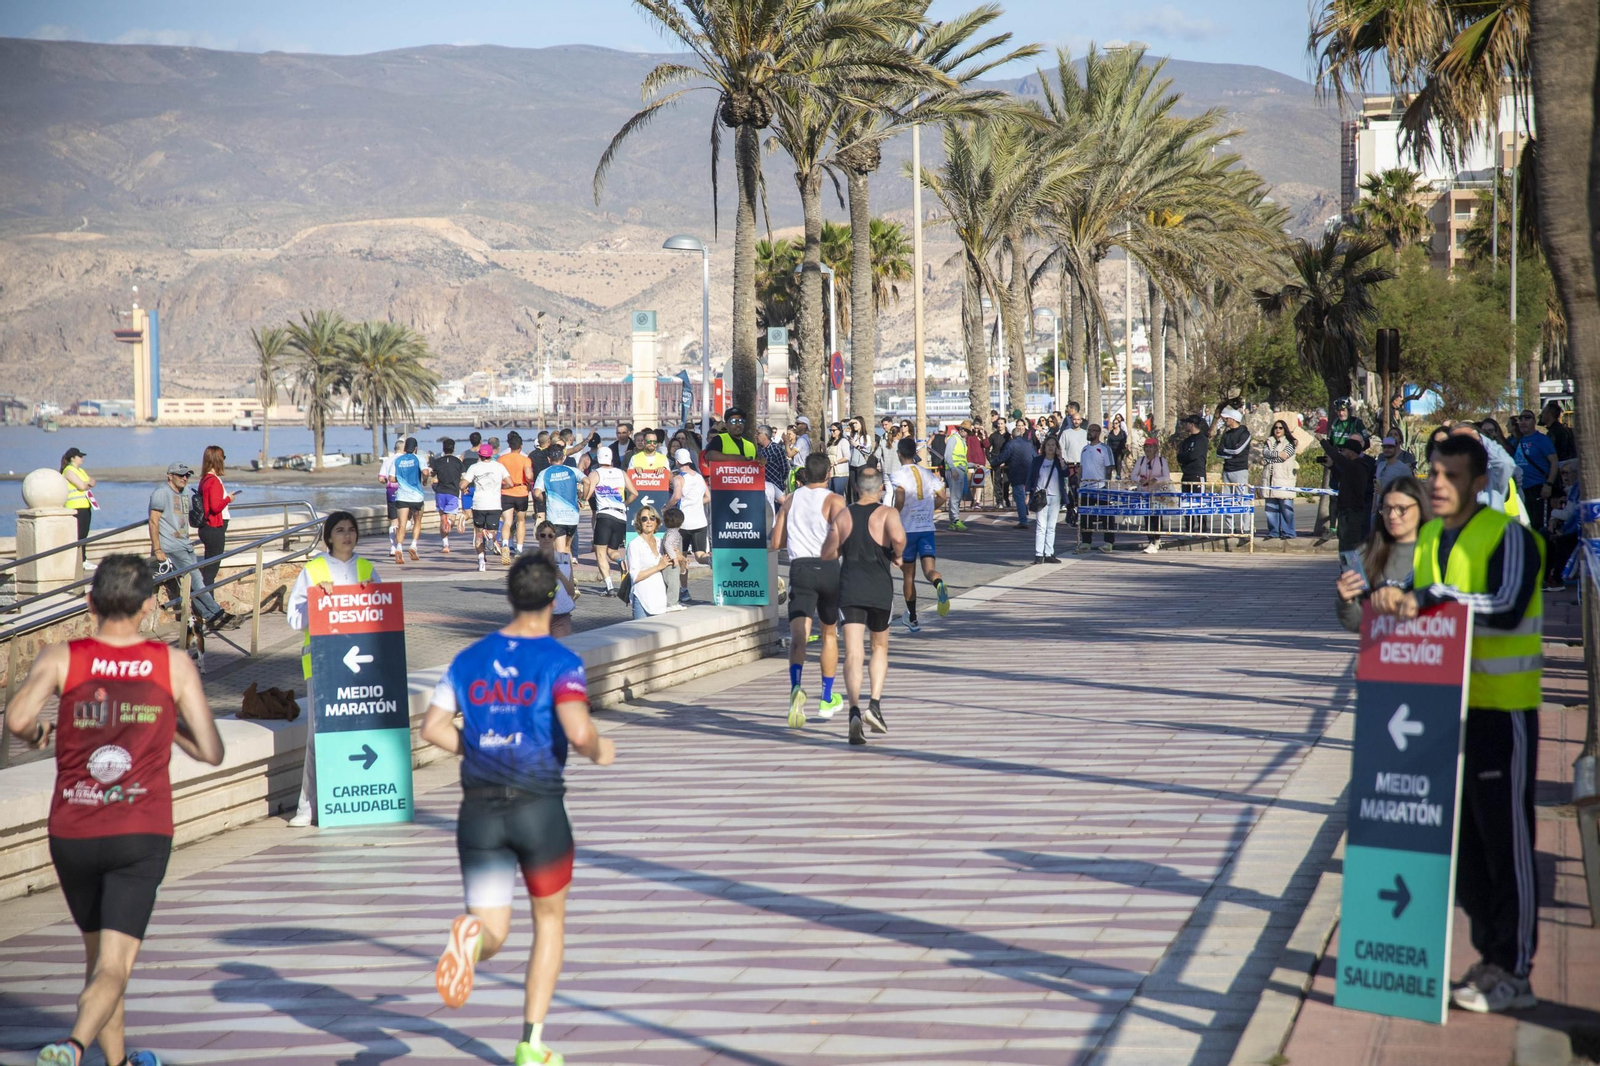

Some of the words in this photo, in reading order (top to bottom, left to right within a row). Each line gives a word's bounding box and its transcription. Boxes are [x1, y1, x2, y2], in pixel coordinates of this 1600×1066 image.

[716, 465, 759, 475] ¡ATENCIÓN
[636, 478, 660, 486] DESVÍO!
[722, 475, 754, 484] DESVÍO!
[725, 521, 753, 530] MEDIO
[718, 530, 760, 539] MARATÓN
[722, 580, 760, 588] CARRERA
[318, 590, 392, 611] ¡ATENCIÓN
[722, 590, 765, 598] ALUDABLE
[328, 606, 384, 624] DESVÍO!
[1380, 638, 1444, 666] DESVÍO!
[91, 657, 153, 677] MATEO
[337, 685, 384, 700] MEDIO
[468, 679, 537, 706] GALO
[325, 698, 397, 717] MARATÓN
[332, 782, 398, 798] CARRERA
[1375, 772, 1430, 797] MEDIO
[324, 798, 406, 815] SALUDABLE
[1360, 797, 1443, 827] MARATÓN
[1354, 939, 1429, 969] CARRERA
[1343, 965, 1437, 998] SALUDABLE
